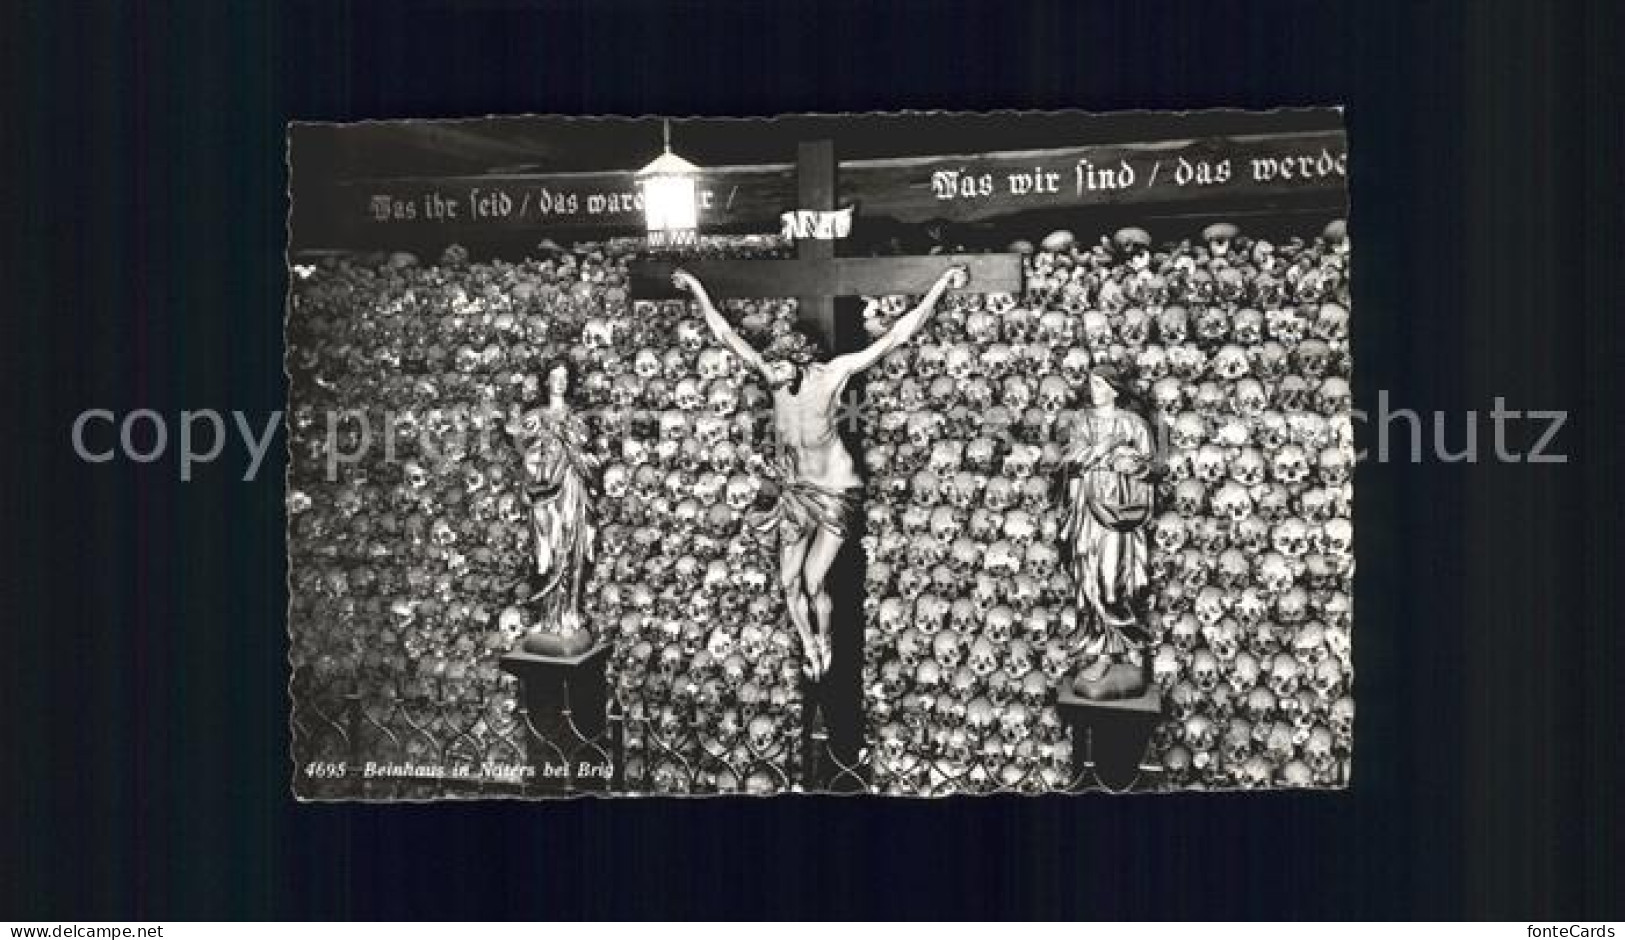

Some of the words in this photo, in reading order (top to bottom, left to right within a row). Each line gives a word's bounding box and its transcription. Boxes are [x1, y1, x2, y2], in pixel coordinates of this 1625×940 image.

[932, 167, 992, 199] Was
[1008, 166, 1060, 195] wir
[1175, 155, 1231, 186] das
[540, 187, 579, 215] das
